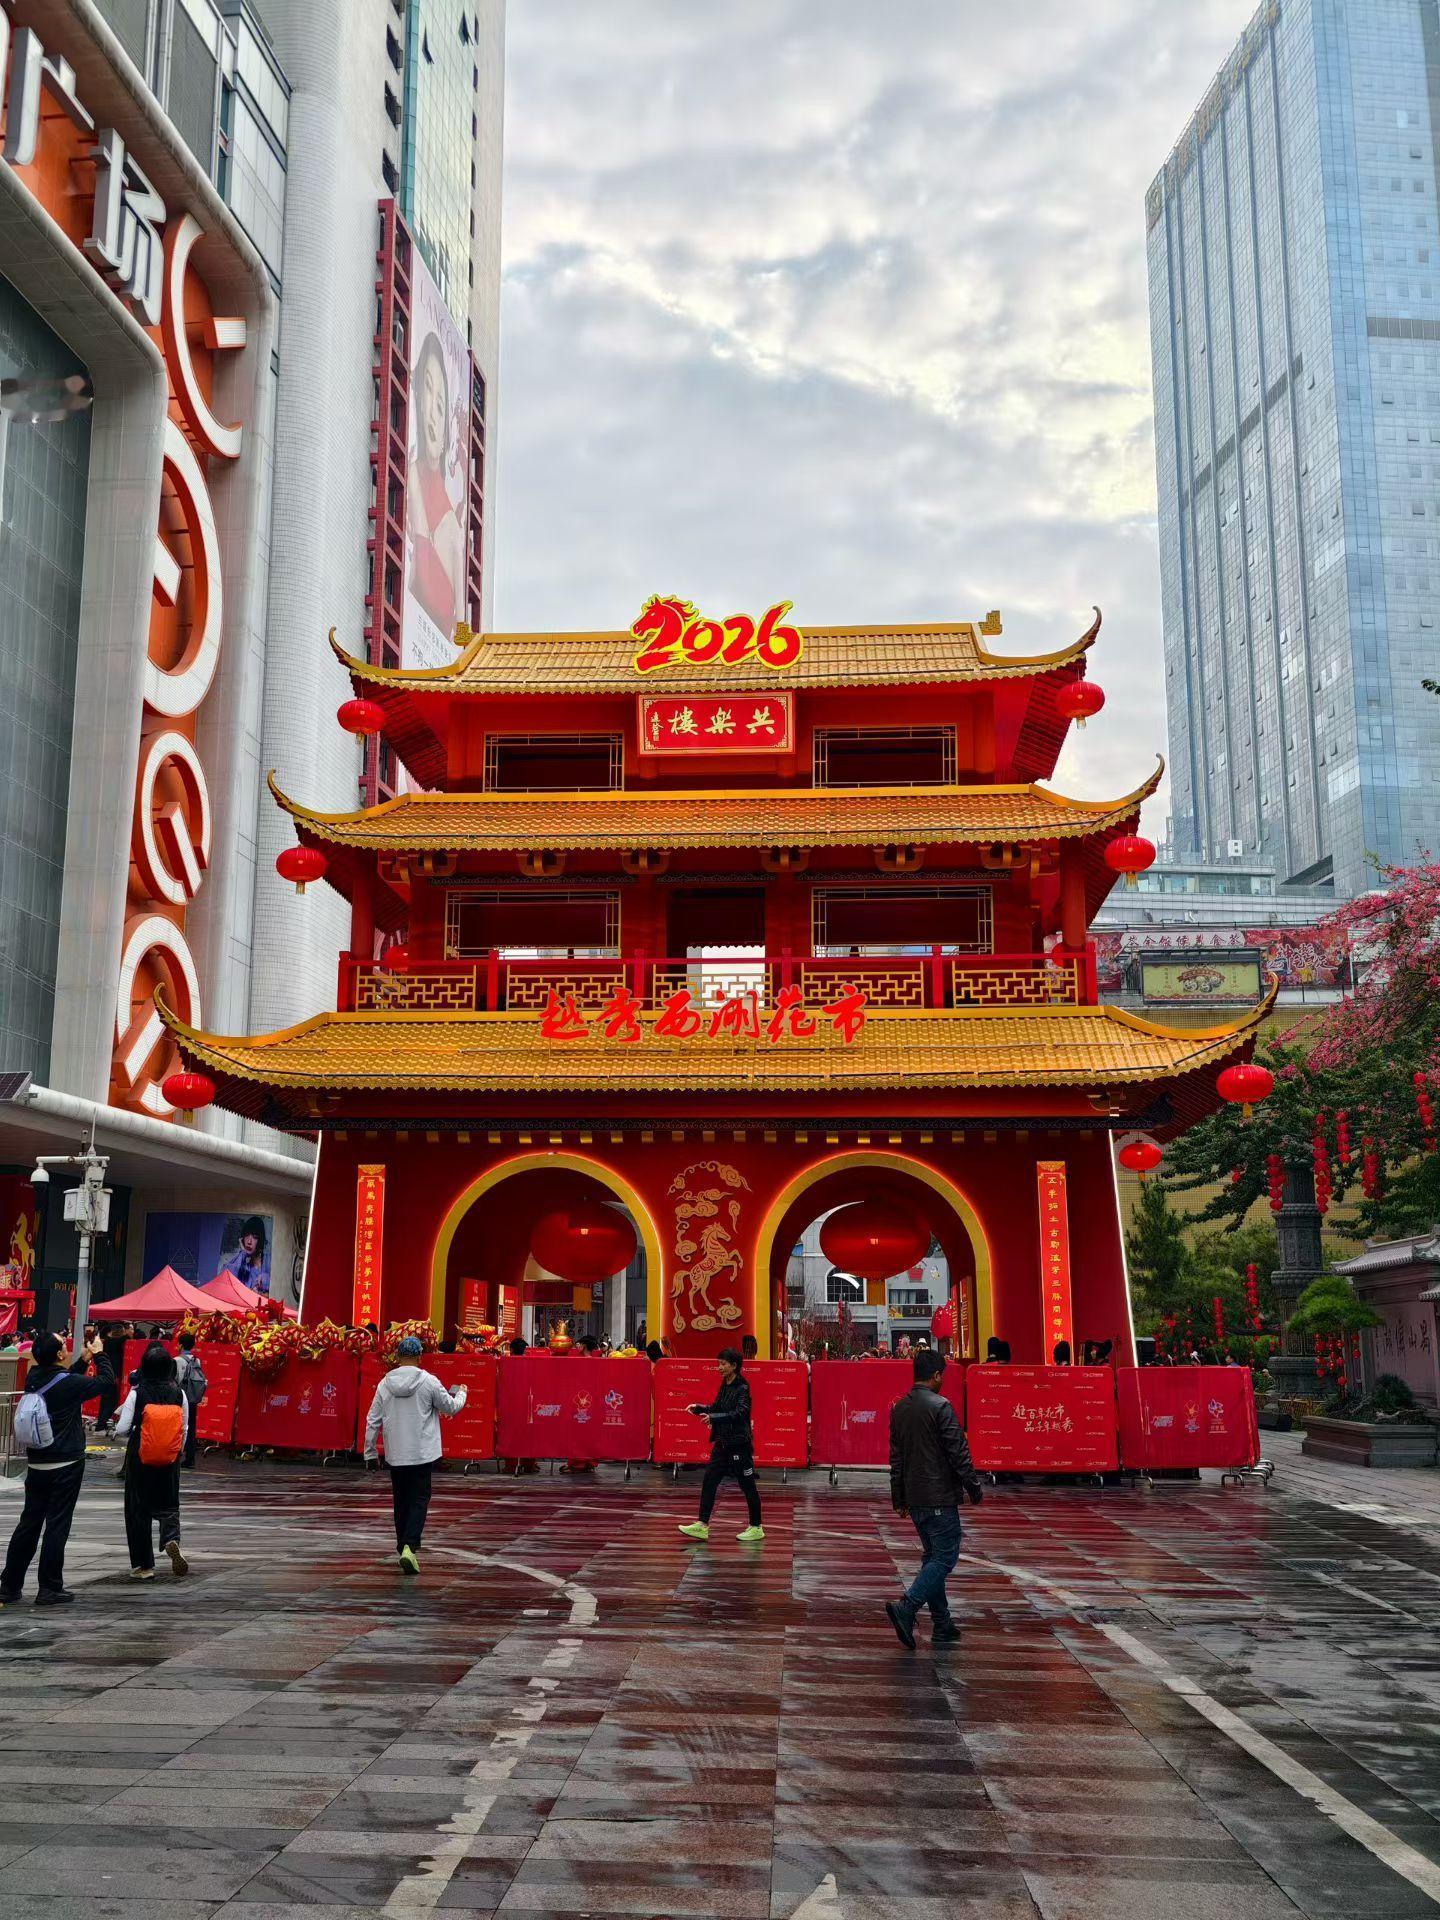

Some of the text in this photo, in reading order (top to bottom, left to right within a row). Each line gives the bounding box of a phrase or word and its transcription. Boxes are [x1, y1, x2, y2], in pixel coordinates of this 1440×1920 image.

[0, 5, 167, 326] 广场
[631, 595, 803, 674] 2026
[538, 984, 867, 1045] 越秀西湖花市
